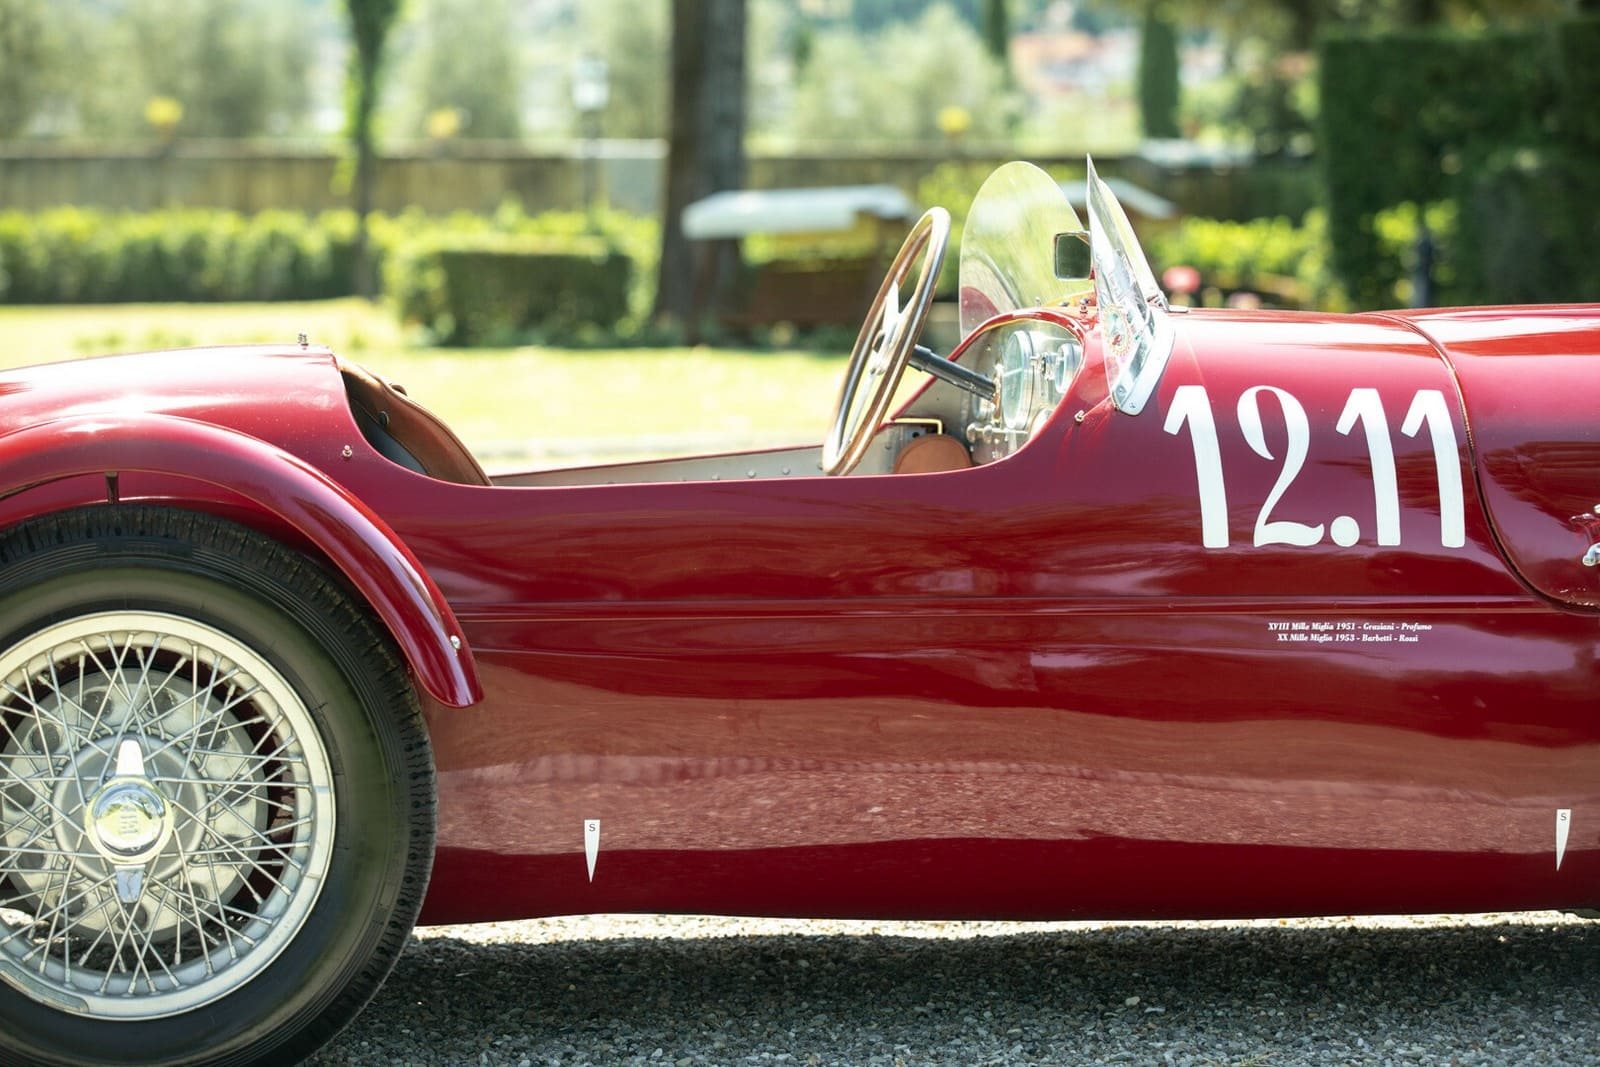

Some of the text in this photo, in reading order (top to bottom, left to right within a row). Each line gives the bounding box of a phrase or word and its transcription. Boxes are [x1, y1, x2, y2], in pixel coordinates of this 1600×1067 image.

[1164, 385, 1466, 549] 12.11
[1268, 622, 1290, 631] XVIII
[1291, 622, 1310, 631] Mille
[1311, 622, 1334, 632] Miglia
[1336, 622, 1356, 631] 1951
[1277, 633, 1289, 642] XX
[1289, 633, 1309, 642] Mille
[1310, 633, 1333, 644] Miglia
[1335, 633, 1355, 642] 1953
[1362, 633, 1393, 642] Barbetti
[1399, 634, 1419, 642] Rossi
[1560, 812, 1567, 821] S
[588, 823, 596, 832] S
